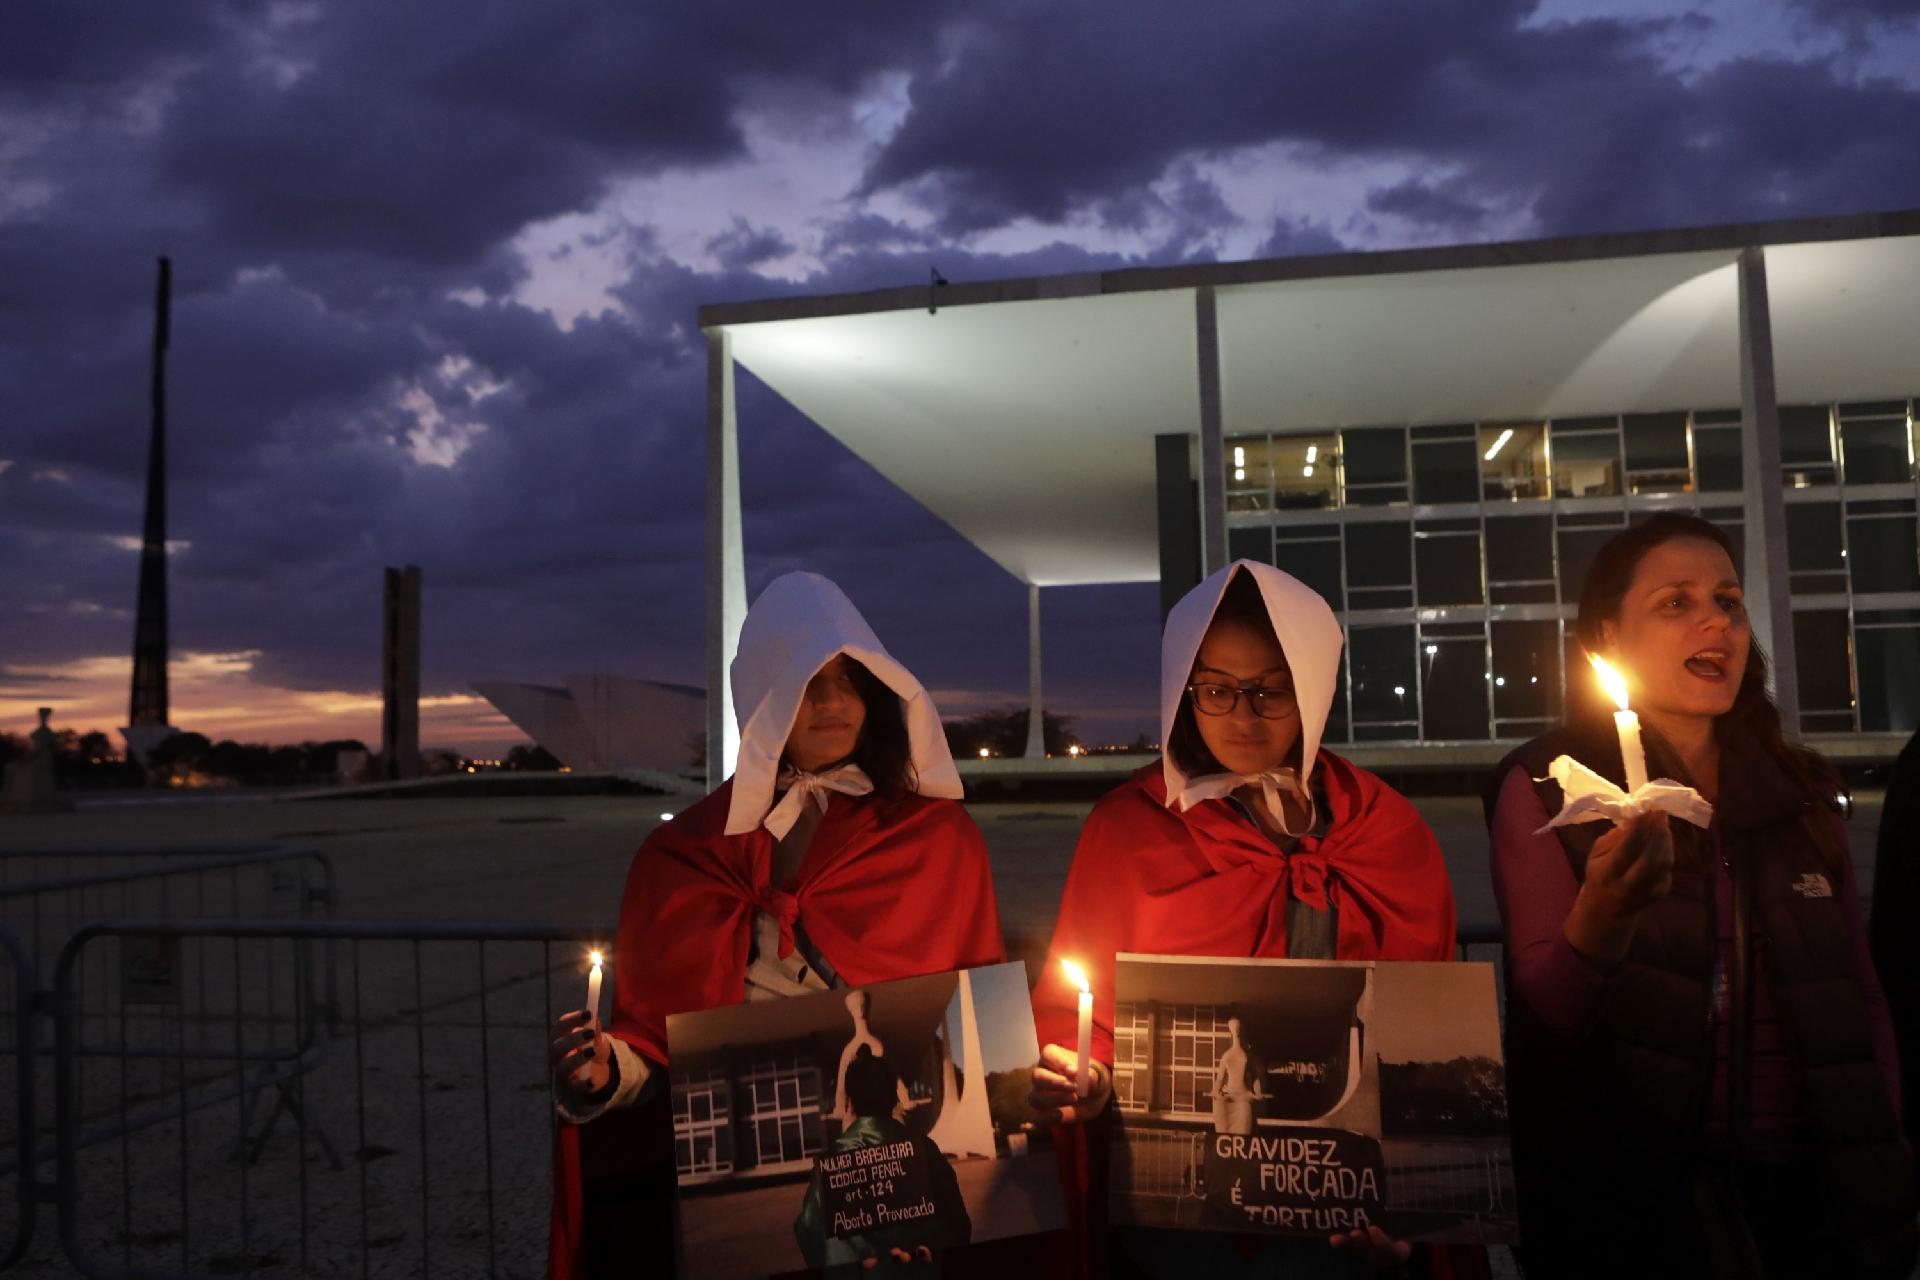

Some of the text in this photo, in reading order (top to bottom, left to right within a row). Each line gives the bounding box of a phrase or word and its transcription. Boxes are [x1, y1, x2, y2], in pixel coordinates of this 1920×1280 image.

[820, 1141, 914, 1172] MULHER BRASILEIRA
[1216, 1135, 1341, 1166] GRAVIDEZ
[871, 1160, 907, 1180] PENAL
[1260, 1163, 1379, 1201] FORÇADA
[1231, 1177, 1243, 1205] É
[834, 1196, 935, 1235] Aborto Provocado
[1244, 1205, 1370, 1230] TORTURA
